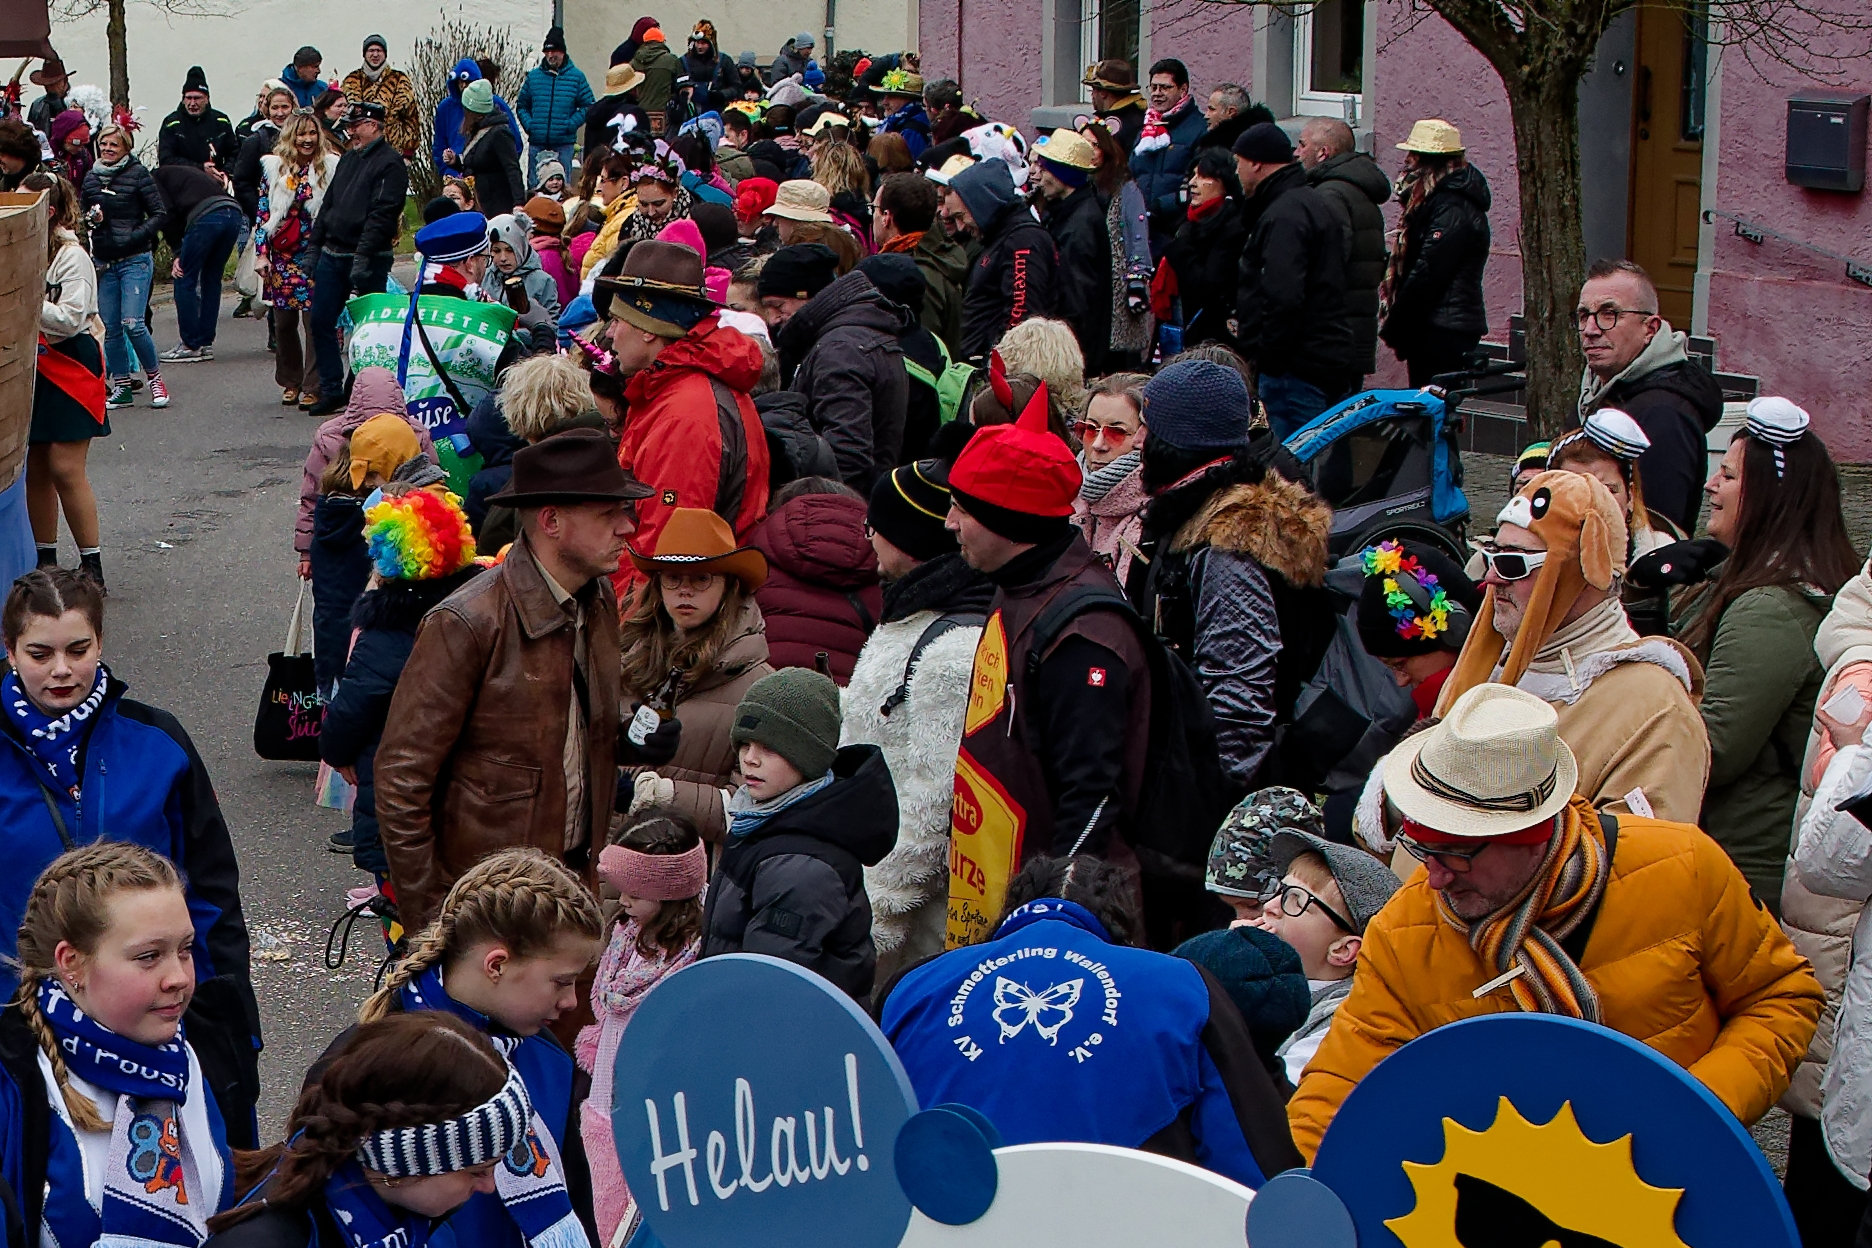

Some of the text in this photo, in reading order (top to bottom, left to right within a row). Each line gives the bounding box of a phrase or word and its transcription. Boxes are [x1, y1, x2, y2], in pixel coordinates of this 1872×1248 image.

[1010, 248, 1031, 326] Luxemb
[947, 947, 1122, 1064] KV Schmetterling Wallendorf e.V.
[645, 1053, 869, 1211] Helau!
